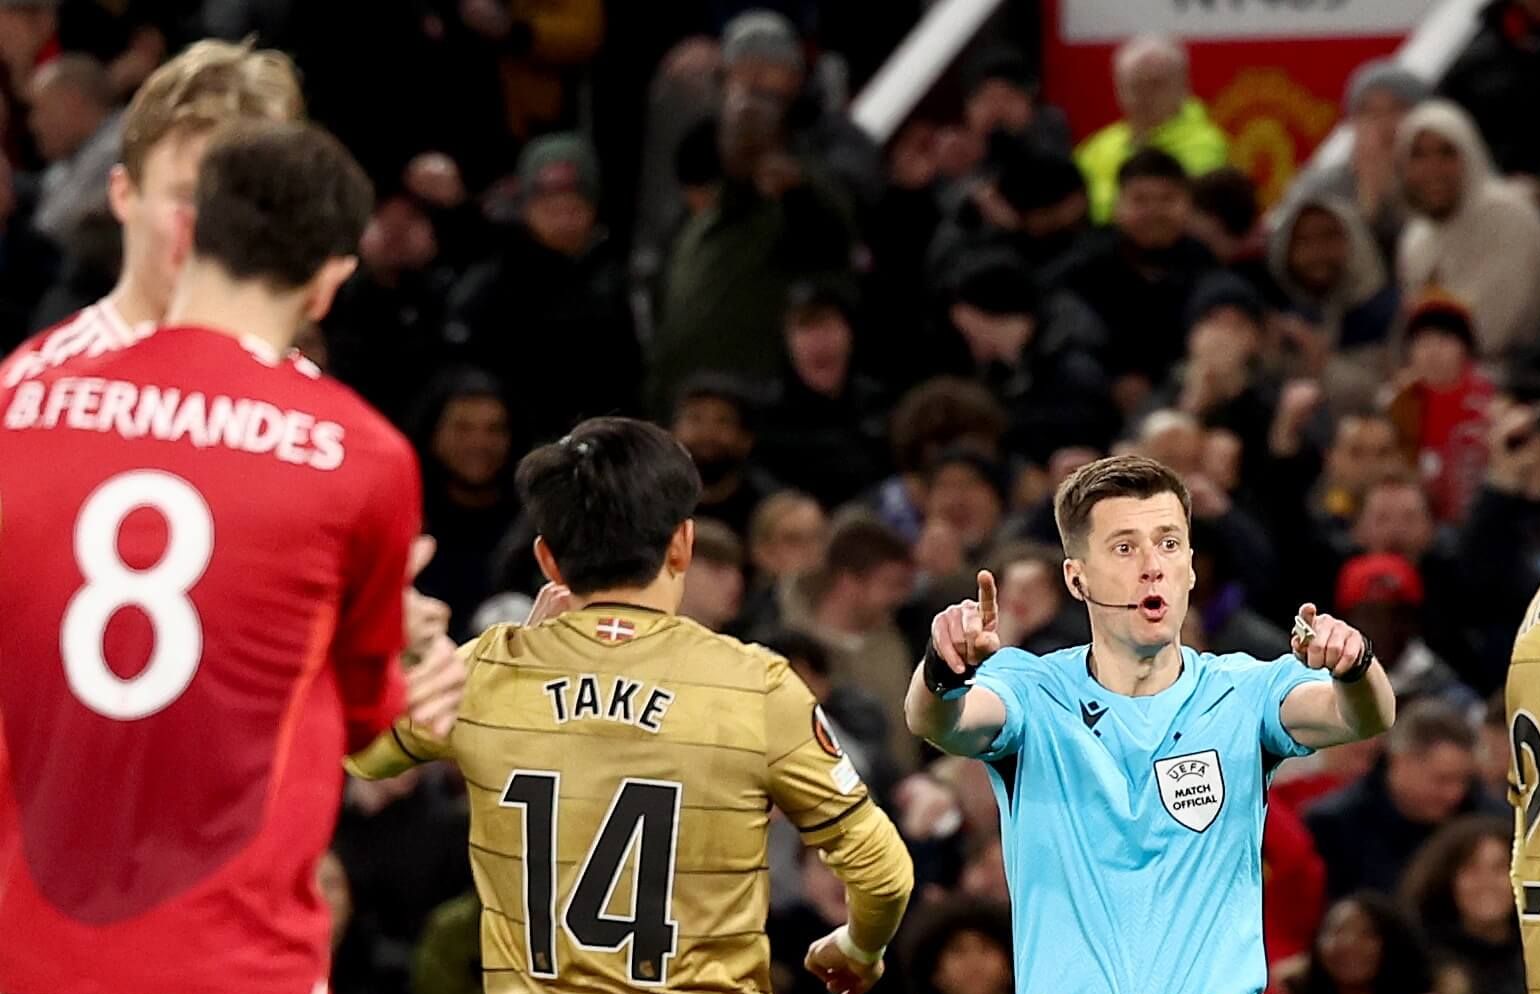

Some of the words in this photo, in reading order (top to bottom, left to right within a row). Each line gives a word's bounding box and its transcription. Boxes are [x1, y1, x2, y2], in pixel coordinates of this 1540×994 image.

[4, 377, 345, 471] B.FERNANDES
[59, 468, 216, 721] 8
[546, 673, 672, 734] TAKE
[1168, 762, 1206, 780] UEFA
[1174, 784, 1211, 798] MATCH
[1172, 795, 1217, 811] OFFICIAL
[499, 769, 682, 987] 14
